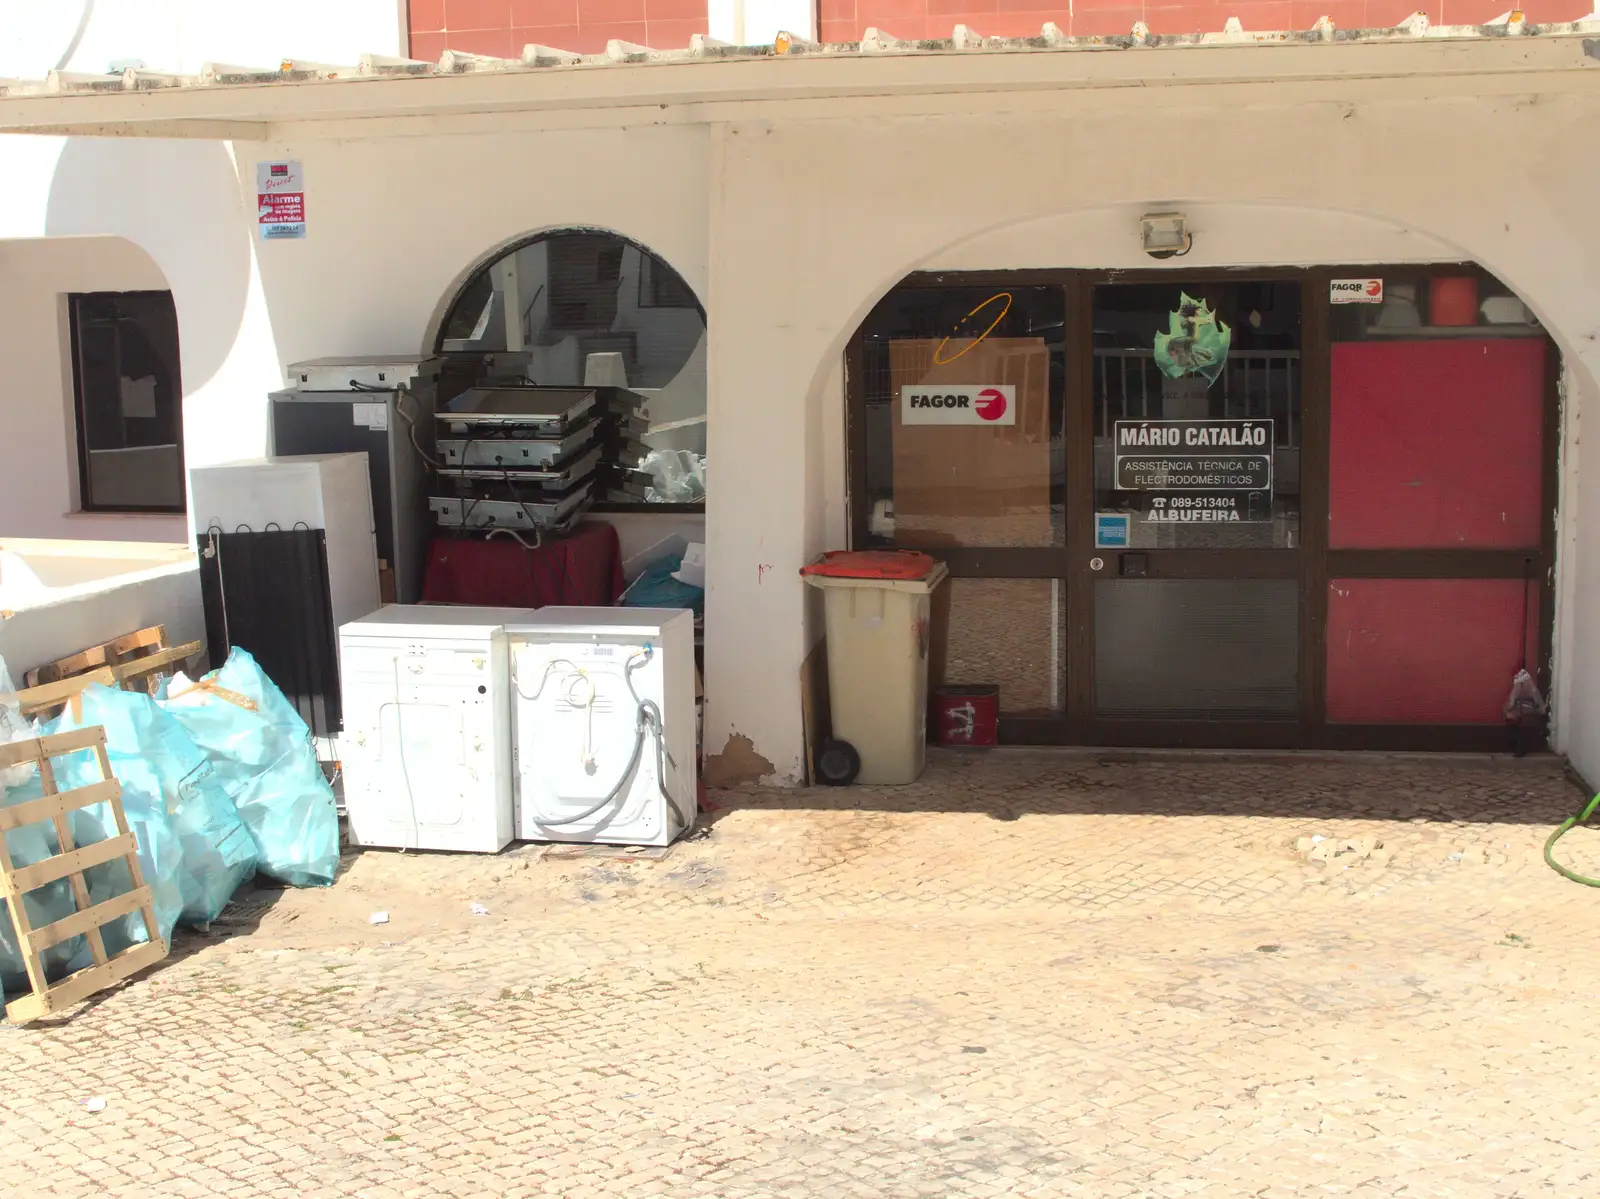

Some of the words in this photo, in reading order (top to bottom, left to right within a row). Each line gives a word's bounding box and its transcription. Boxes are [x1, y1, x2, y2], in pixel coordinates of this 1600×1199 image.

[262, 194, 301, 203] Alarme
[1331, 283, 1363, 291] FAGOR
[910, 394, 970, 409] FAGOR
[1120, 423, 1180, 446] MÁRIO
[1185, 423, 1266, 446] CATALÃO
[1125, 460, 1193, 471] ASSISTÊNCIA
[1198, 460, 1243, 471] TÉCNICA
[1248, 461, 1262, 470] DE
[1135, 473, 1253, 485] ELECTRODOMÉSTICOS
[1171, 497, 1236, 508] 089-513404
[1147, 509, 1240, 521] ALBUFEIRA
